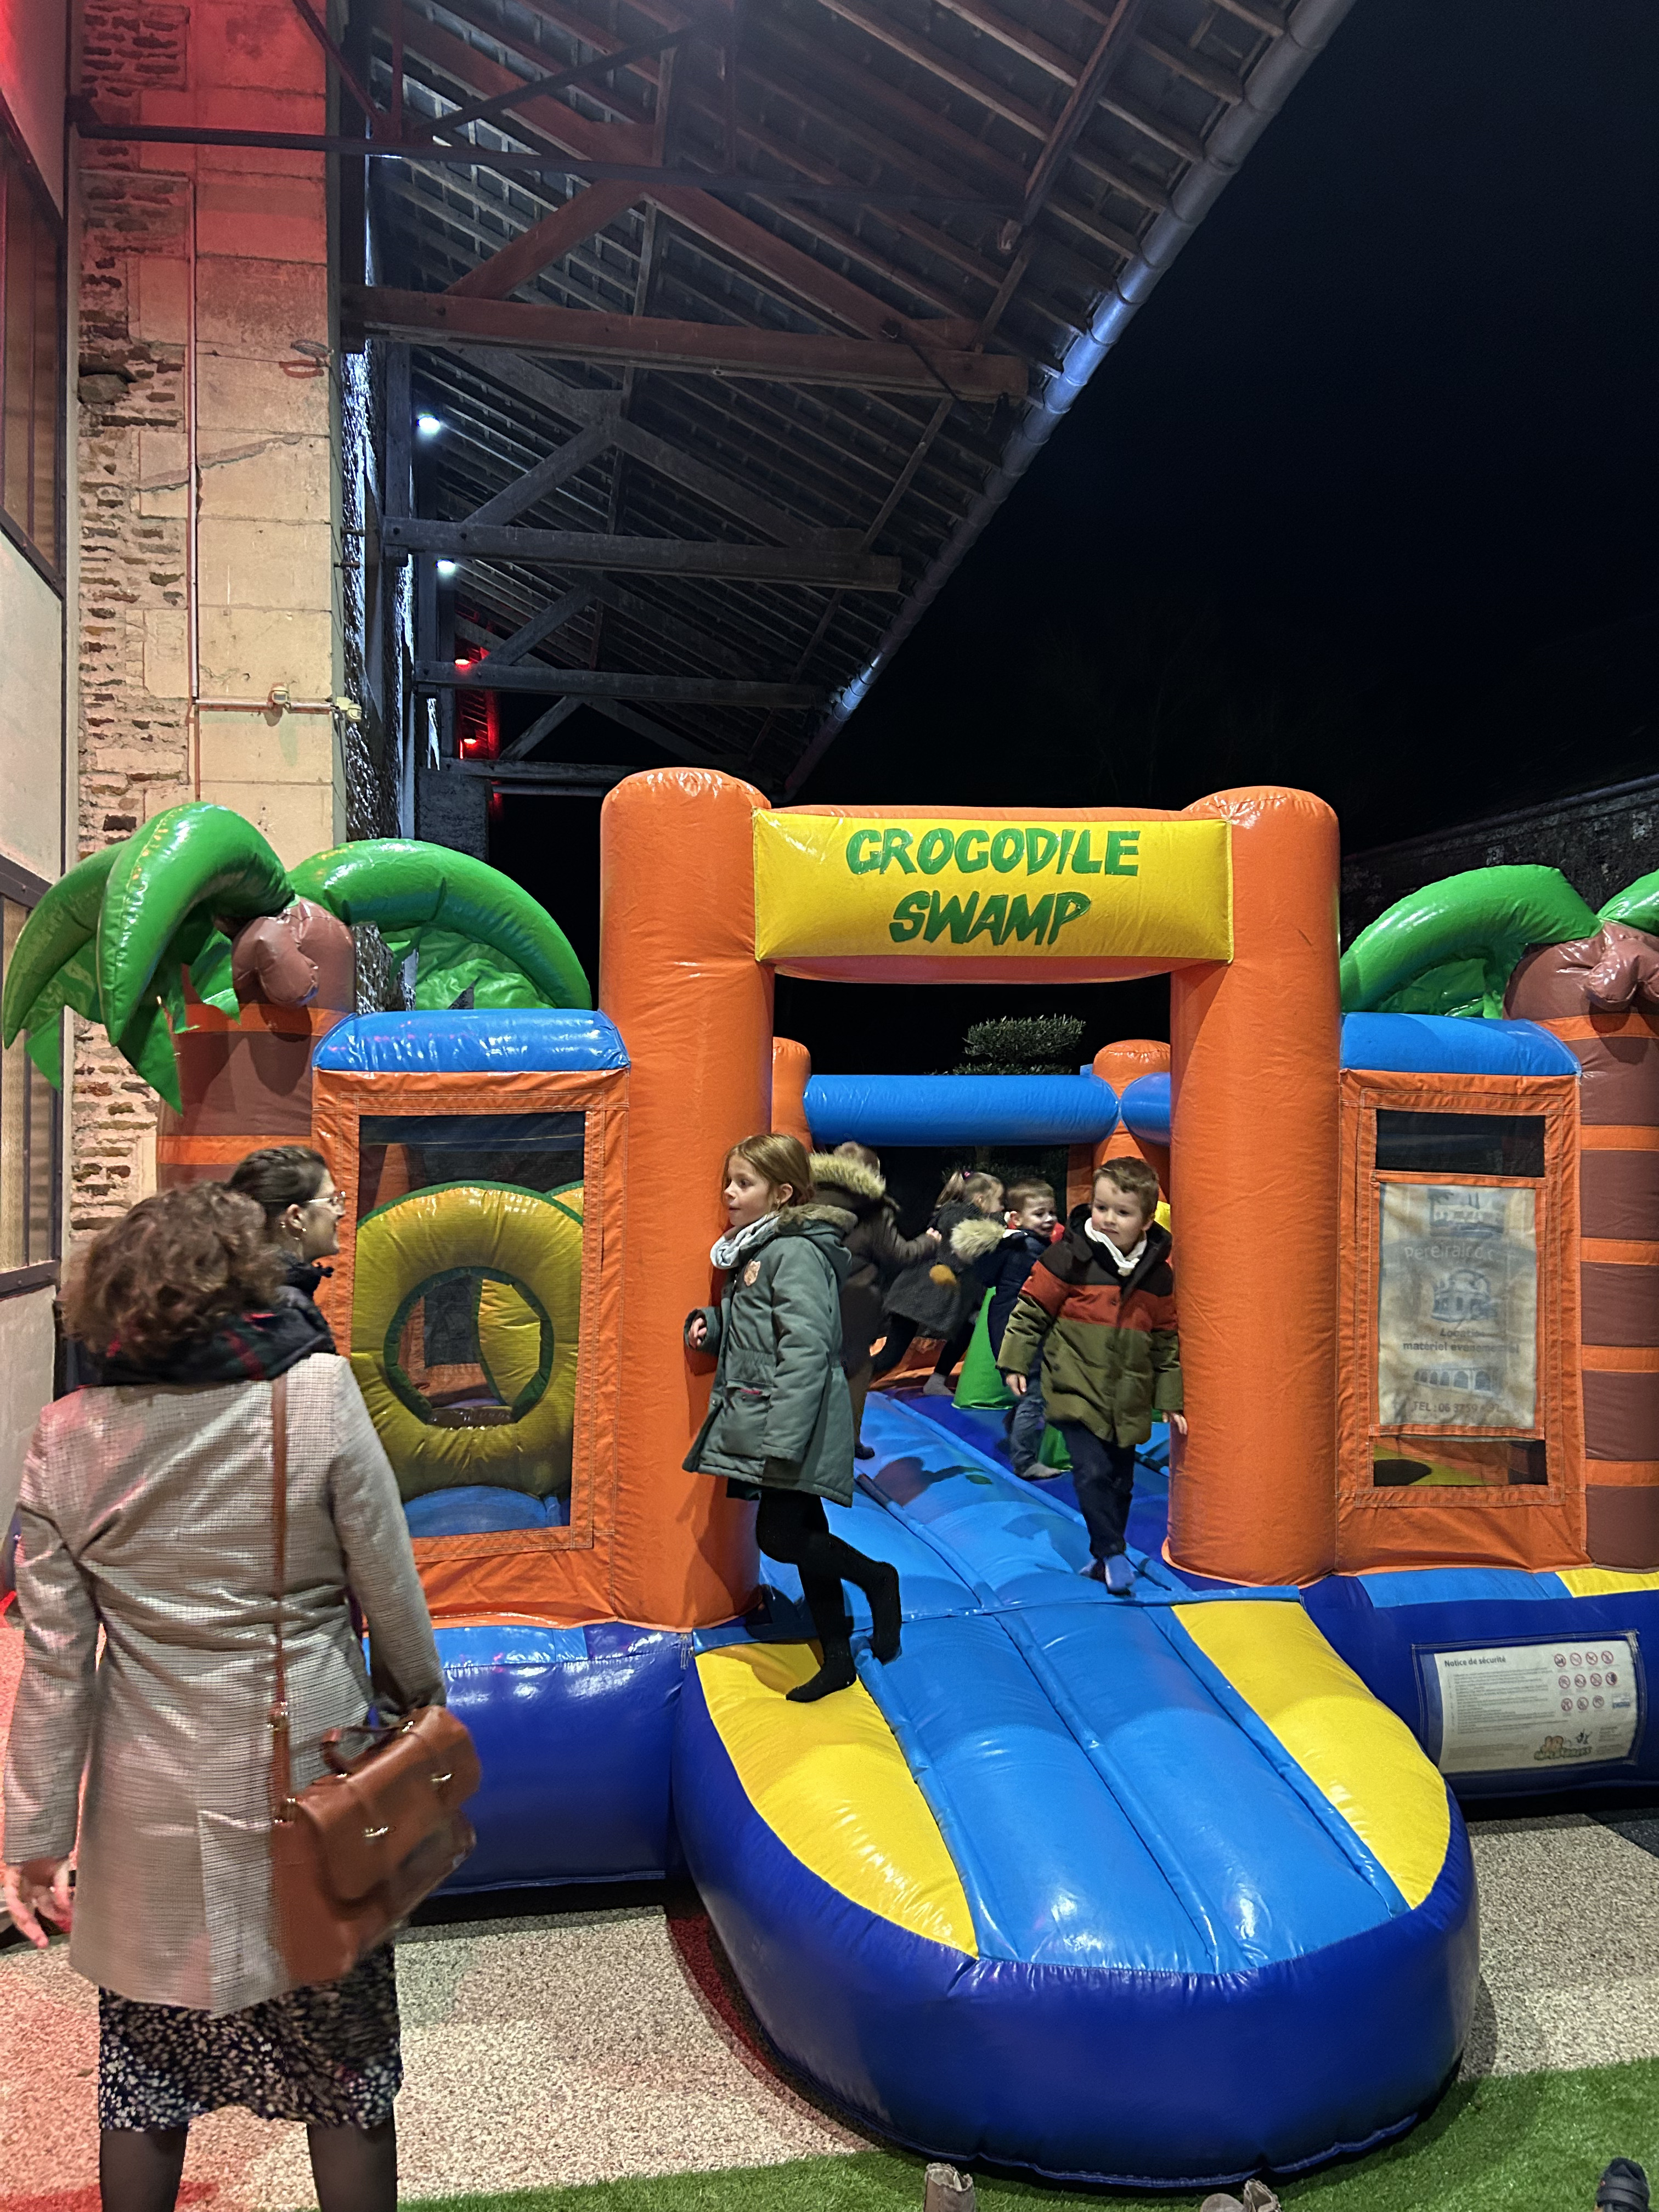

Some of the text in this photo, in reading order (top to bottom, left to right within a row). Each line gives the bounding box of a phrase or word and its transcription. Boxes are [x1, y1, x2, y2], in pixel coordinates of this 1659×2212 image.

[845, 827, 1141, 877] CROCODILE
[889, 890, 1092, 946] SWAMP
[1444, 1655, 1506, 1667] Notice de sécurité
